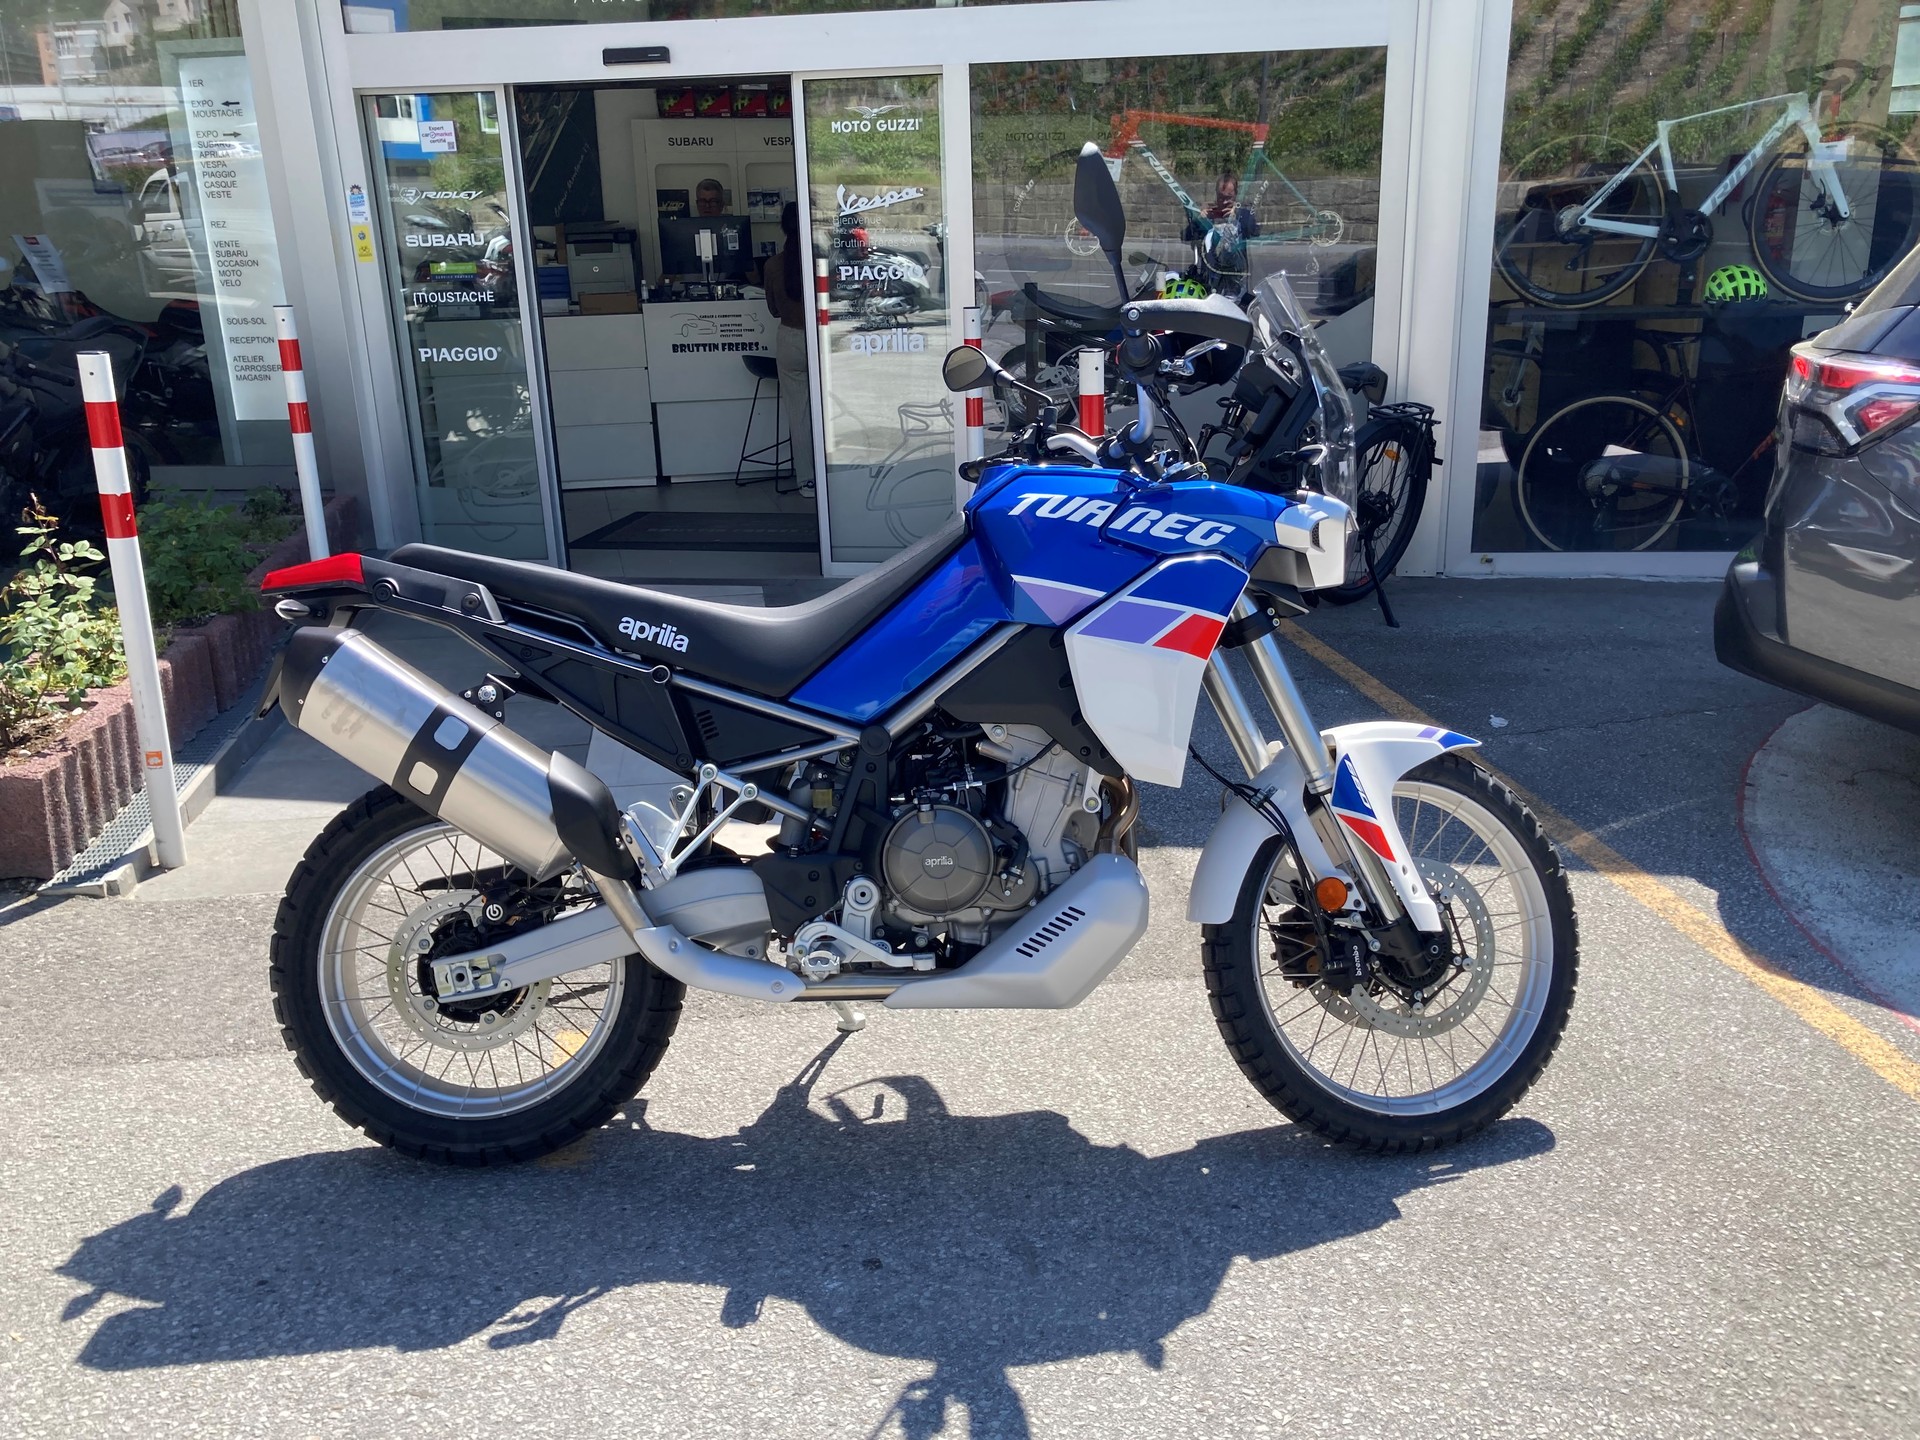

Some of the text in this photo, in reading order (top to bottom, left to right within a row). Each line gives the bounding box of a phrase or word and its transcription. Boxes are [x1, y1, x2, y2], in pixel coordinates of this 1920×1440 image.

[188, 79, 204, 87] 1ER
[191, 100, 214, 108] EXPO
[192, 109, 244, 118] MOUSTACHE
[831, 119, 919, 133] MOTO GUZZI
[196, 130, 219, 139] EXPO
[668, 137, 714, 147] SUBARU
[200, 160, 227, 169] VESPA
[202, 170, 237, 179] PIAGGIO
[204, 181, 238, 189] CASQUE
[1142, 151, 1201, 213] RIDLEY
[205, 190, 232, 198] VESTE
[421, 190, 483, 200] RIDLEY
[836, 184, 924, 216] Vespa
[210, 220, 227, 228] REZ
[833, 215, 882, 226] Bienvenue
[213, 240, 240, 248] VENTE
[405, 233, 485, 247] SUBARU
[834, 237, 866, 248] Bruttin
[215, 250, 248, 258] SUBARU
[217, 259, 259, 268] OCCASION
[839, 265, 923, 281] PIAGGIO
[220, 279, 241, 287] VELO
[413, 291, 495, 307] MOUSTACHE
[226, 317, 267, 325] SOUS-SOL
[229, 336, 275, 344] RECEPTION
[851, 328, 924, 357] aprilia
[672, 343, 719, 353] BRUTTIN
[721, 341, 760, 352] FRERES
[232, 355, 264, 363] ATELIER
[418, 347, 498, 362] PIAGGIO
[234, 364, 282, 372] CARROSSER
[235, 374, 272, 382] MAGASIN
[1007, 492, 1236, 547] TUAREG
[618, 616, 689, 653] aprilia
[925, 855, 953, 868] aprilia
[1352, 945, 1362, 976] brembo
